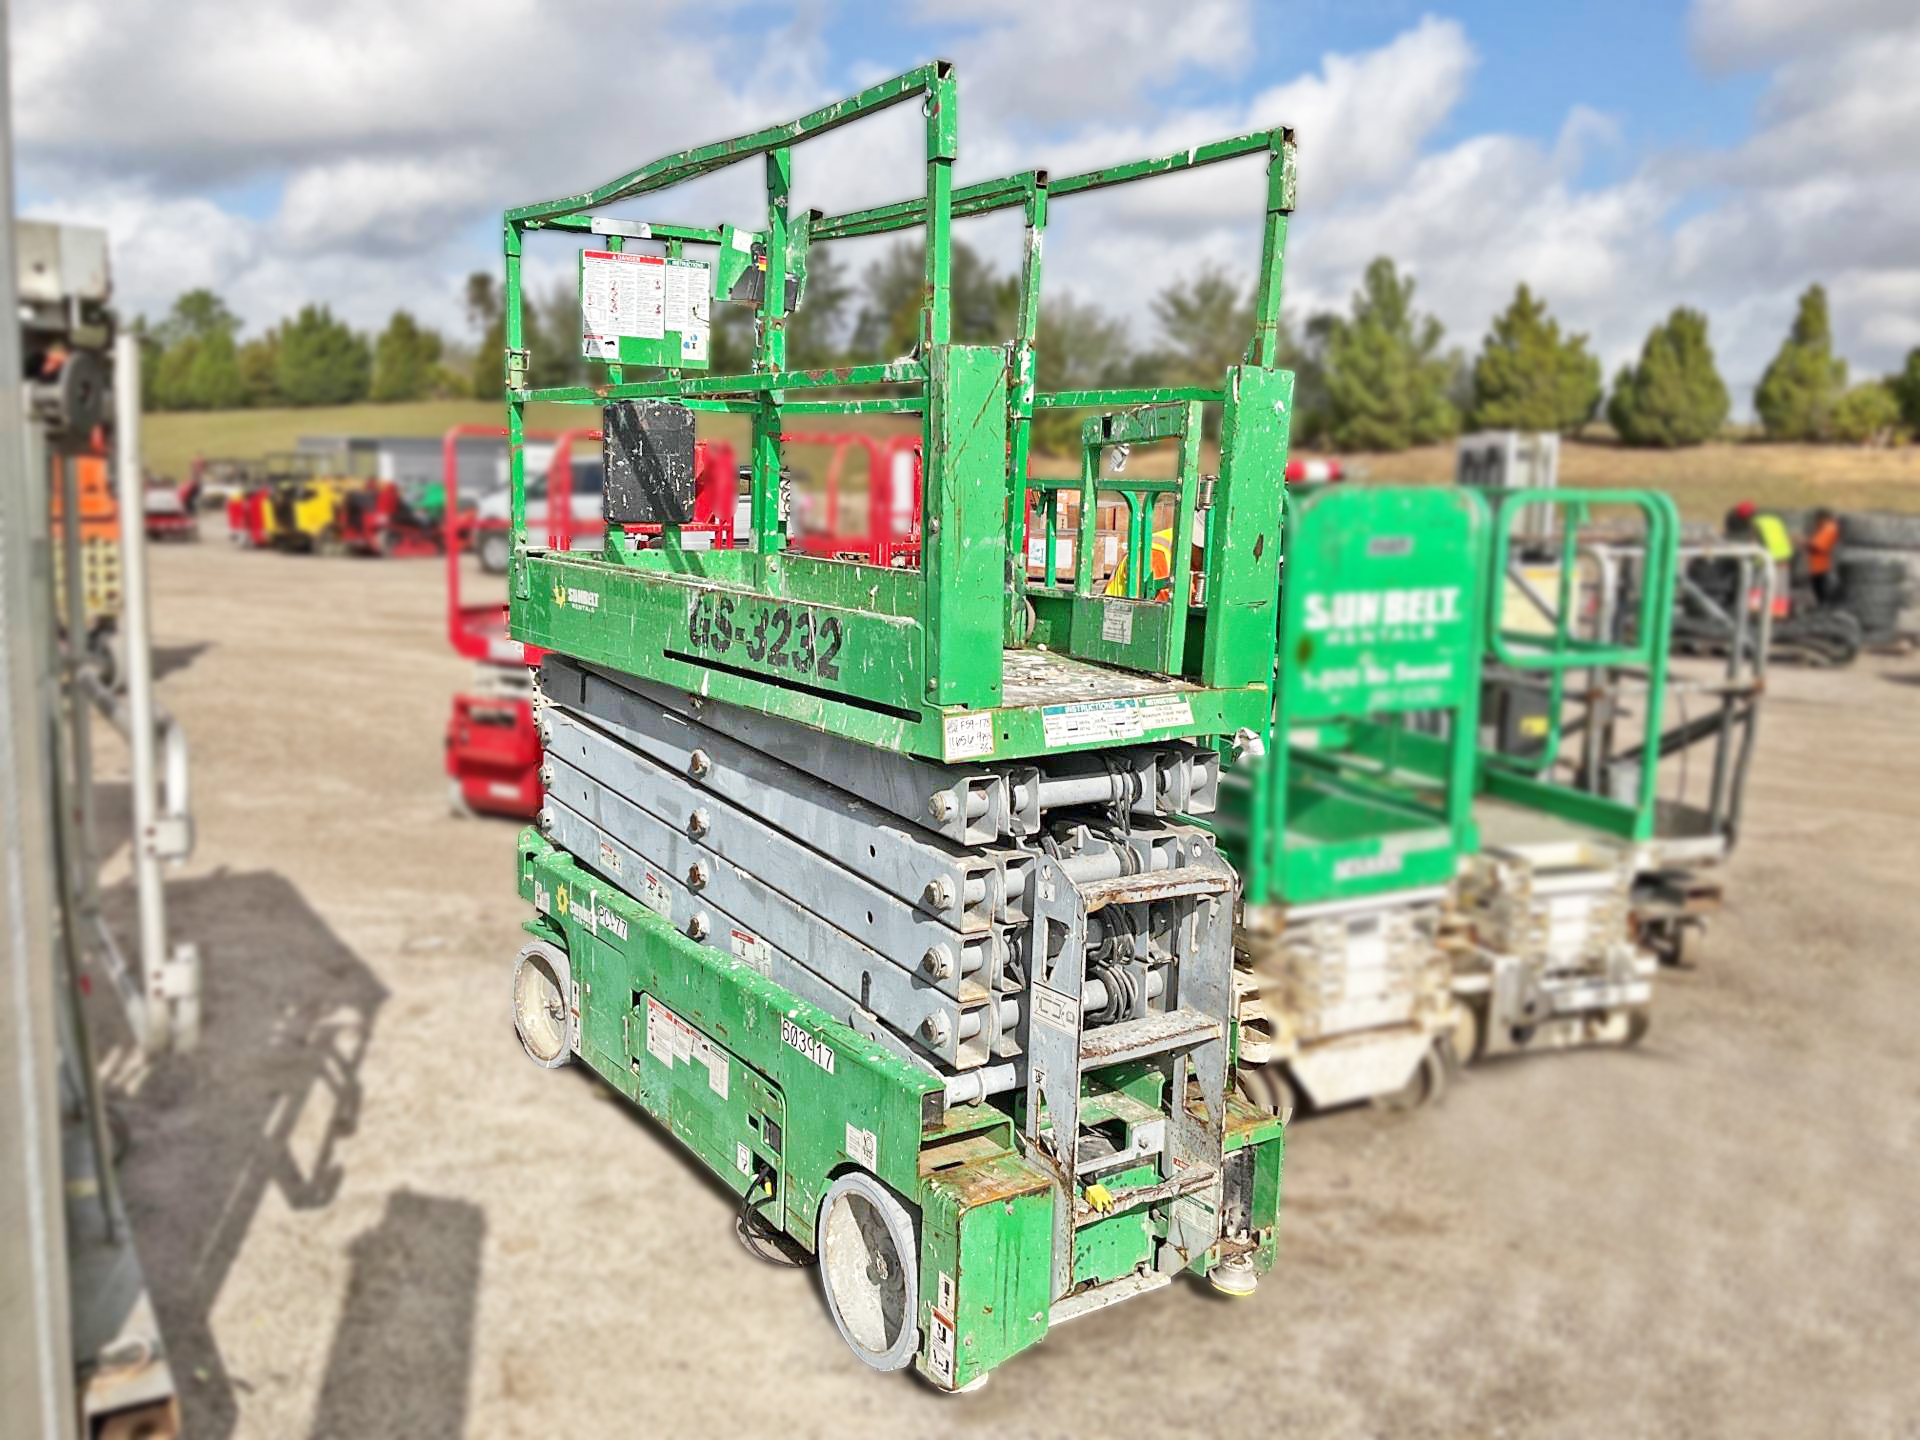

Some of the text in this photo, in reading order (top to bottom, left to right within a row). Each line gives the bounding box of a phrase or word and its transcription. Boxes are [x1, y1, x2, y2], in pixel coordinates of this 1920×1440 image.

[1303, 586, 1460, 630] SUNBELT
[689, 597, 843, 681] GS-3232
[782, 1020, 832, 1069] 603917
